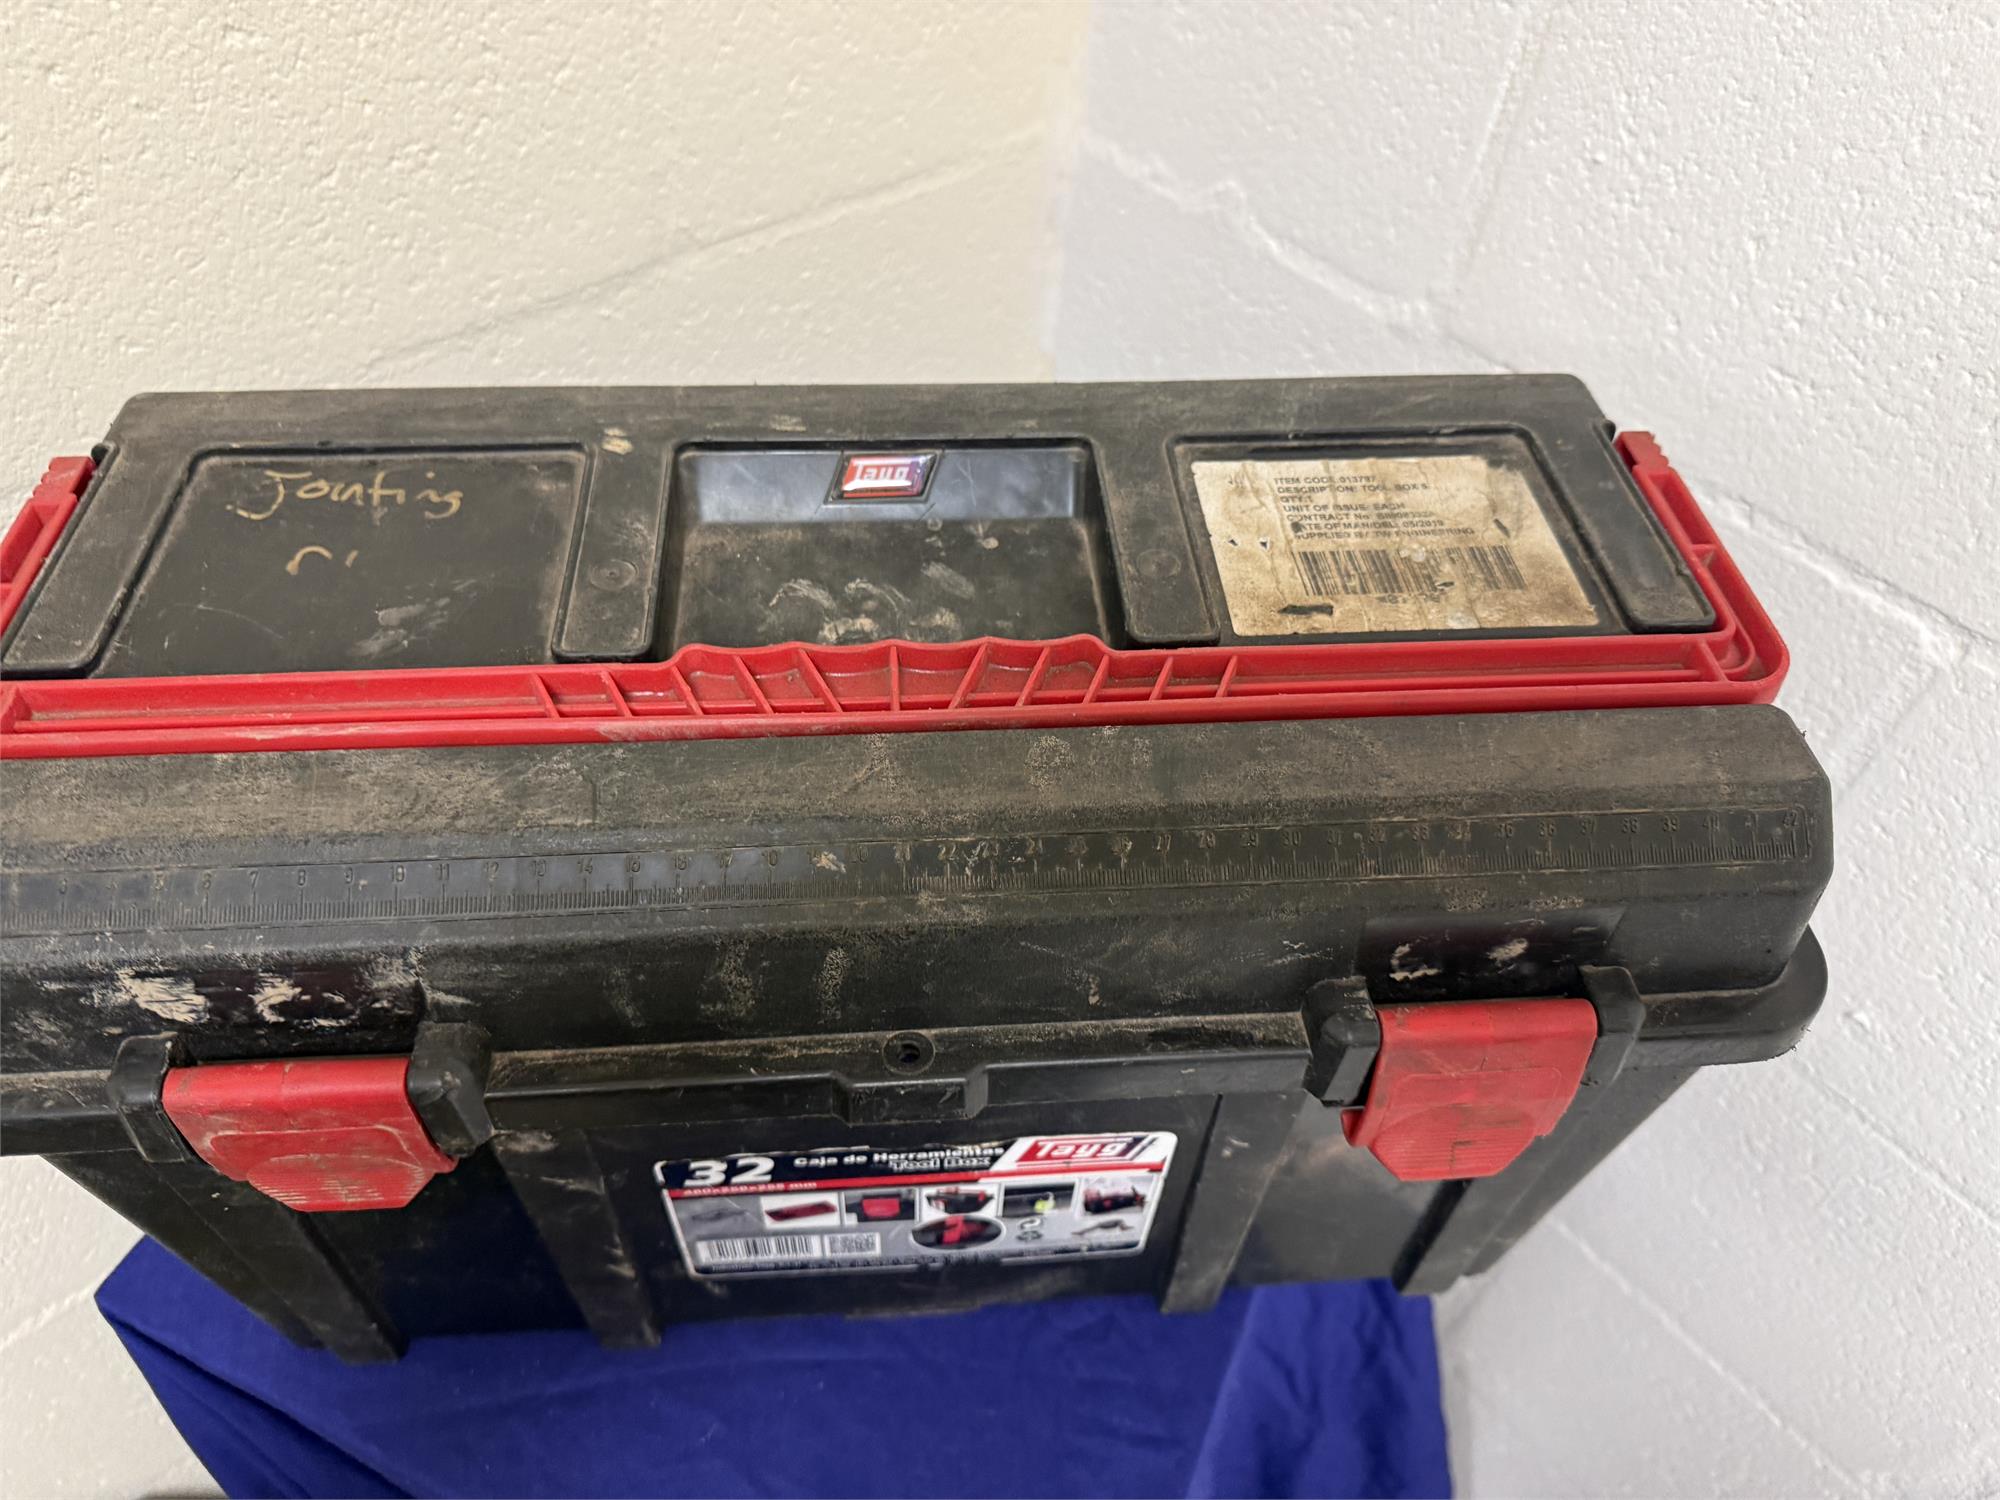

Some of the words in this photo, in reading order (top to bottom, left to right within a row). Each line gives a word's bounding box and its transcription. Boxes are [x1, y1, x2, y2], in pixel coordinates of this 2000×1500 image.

[1274, 477, 1301, 485] ITEM
[1277, 485, 1357, 494] DESCRIPON:
[1283, 504, 1310, 512] UNIT
[1313, 504, 1329, 512] OF
[1373, 502, 1406, 510] EACH
[1286, 512, 1350, 521] CONTRACT
[1291, 522, 1322, 531] ATE
[1324, 522, 1341, 530] OF
[1036, 1139, 1129, 1158] Tayg
[793, 1155, 838, 1168] Caja
[843, 1154, 868, 1165] de
[873, 1147, 1005, 1162] Herramientas
[889, 1158, 940, 1172] Tool
[944, 1156, 991, 1169] Box
[683, 1157, 775, 1187] 32
